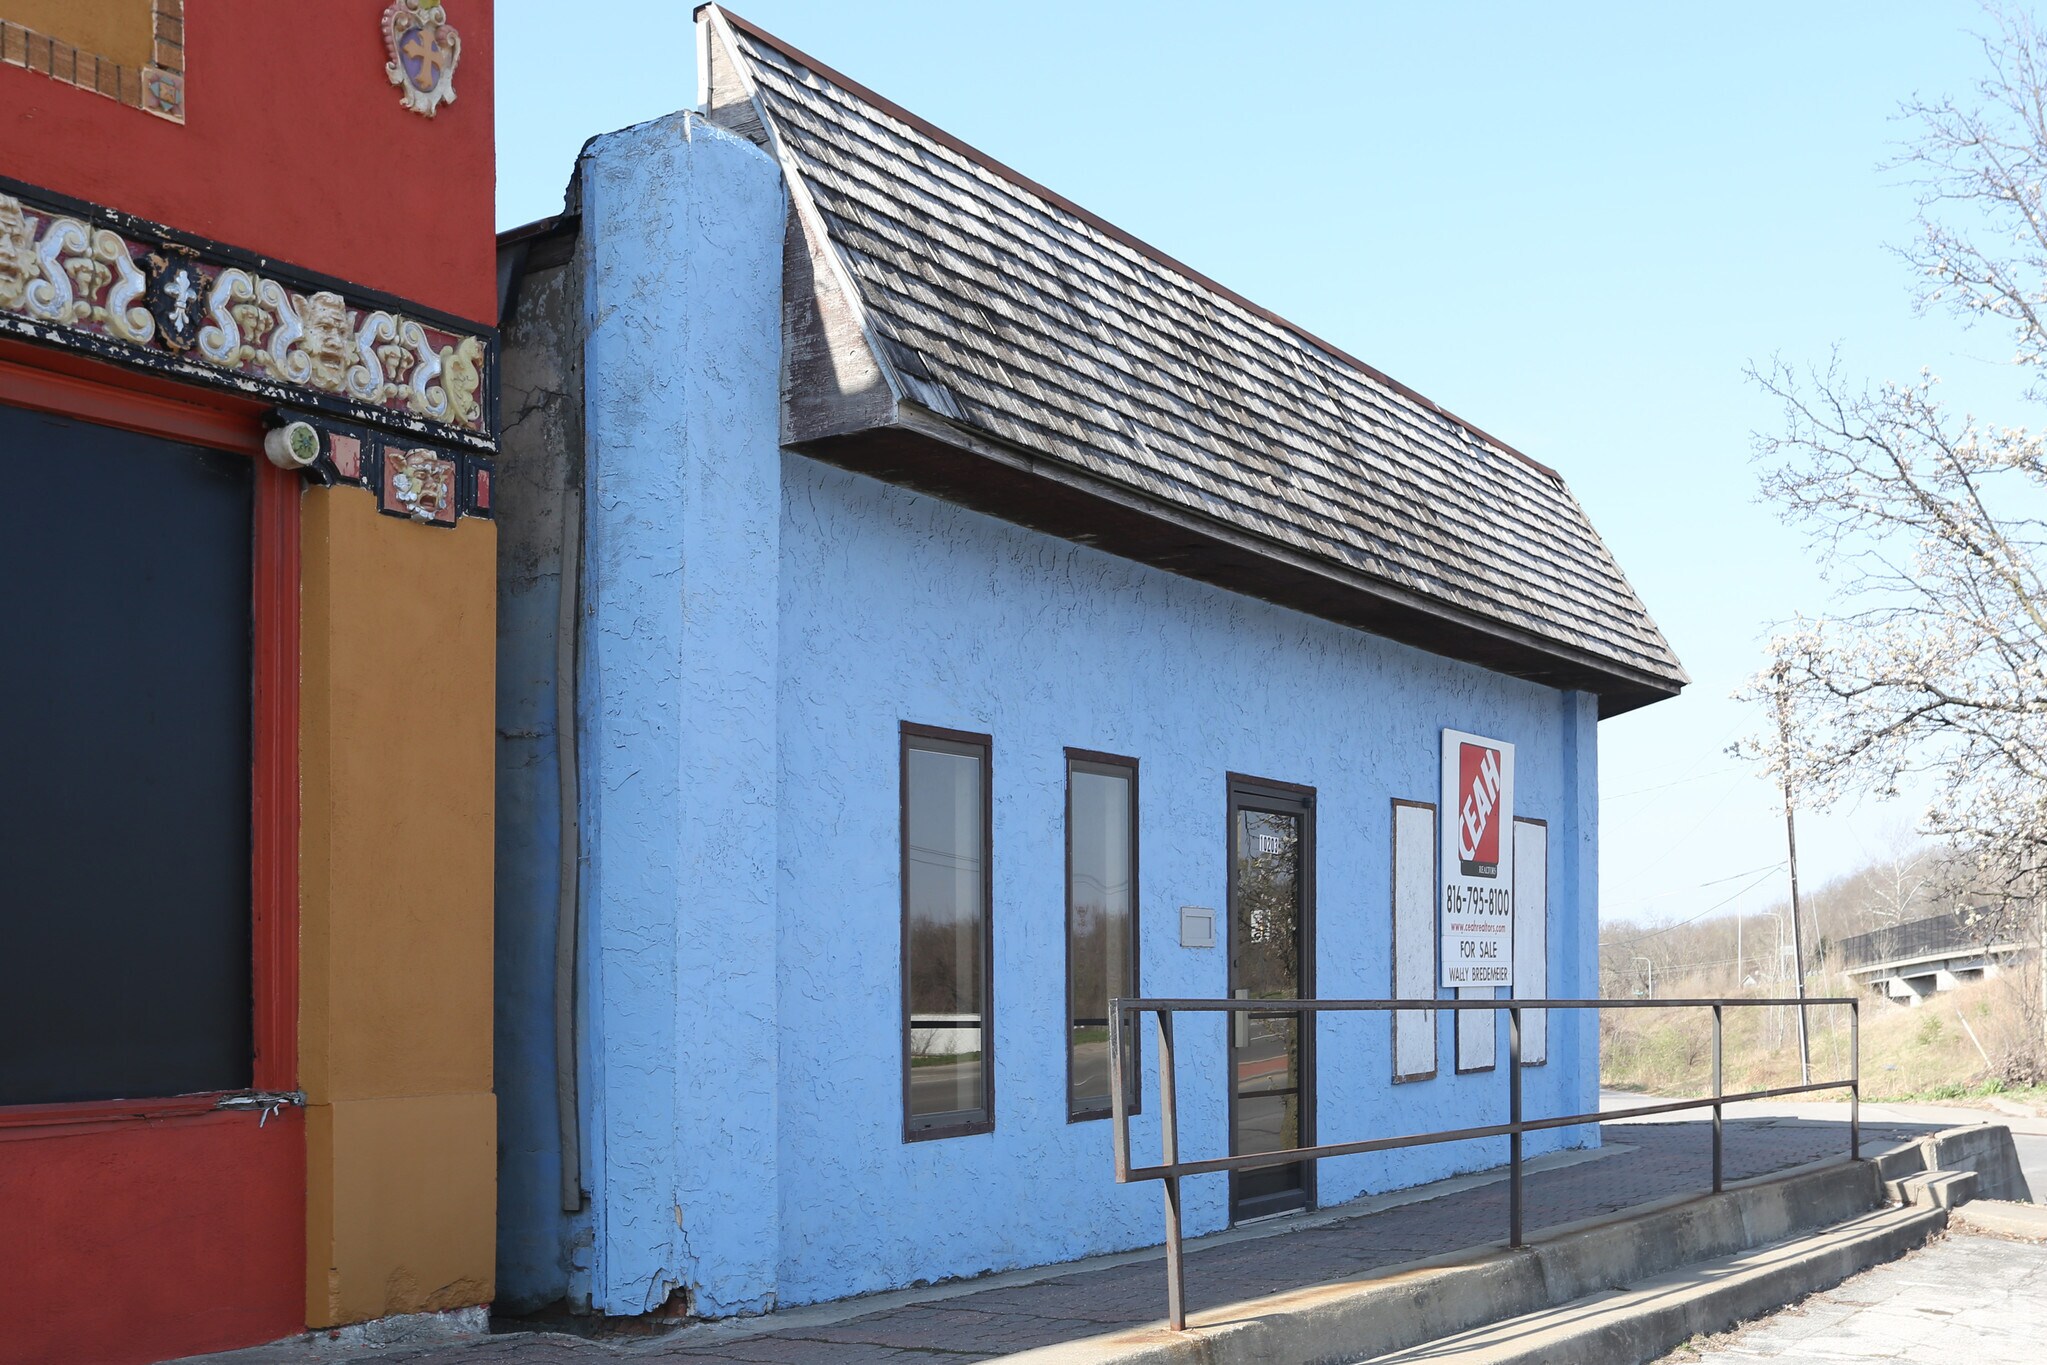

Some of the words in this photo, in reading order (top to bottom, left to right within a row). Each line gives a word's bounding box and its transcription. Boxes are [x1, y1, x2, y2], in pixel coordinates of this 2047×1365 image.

[1459, 749, 1500, 860] CEAH
[1446, 884, 1509, 916] 816-795-8100
[1451, 920, 1506, 933] www.ceahrealtors.com
[1460, 941, 1475, 958] FOR
[1480, 941, 1497, 958] SALE
[1449, 967, 1469, 982] WALLY
[1472, 967, 1508, 981] BREDEMEIER
